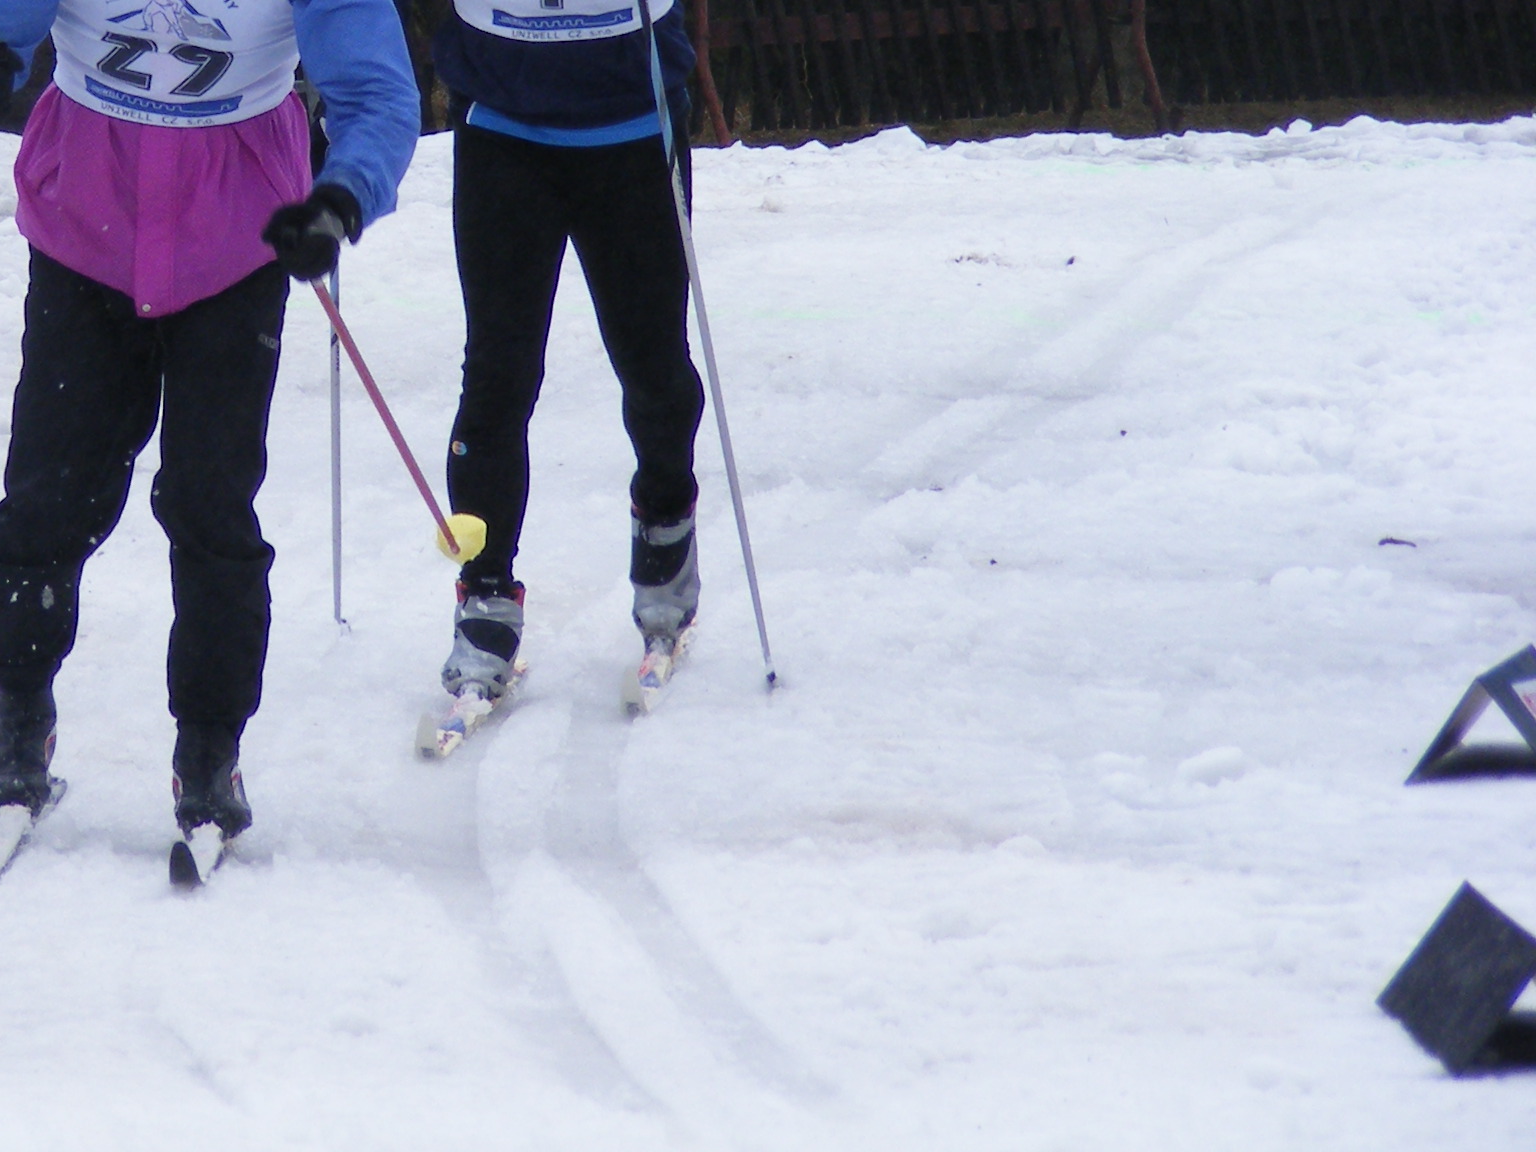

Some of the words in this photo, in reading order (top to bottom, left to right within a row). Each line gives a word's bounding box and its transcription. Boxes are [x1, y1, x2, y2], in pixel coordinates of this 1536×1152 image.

[512, 29, 560, 39] UNIWELL
[568, 30, 582, 38] CZ
[101, 102, 152, 122] UNIWELL
[162, 116, 178, 125] CZ
